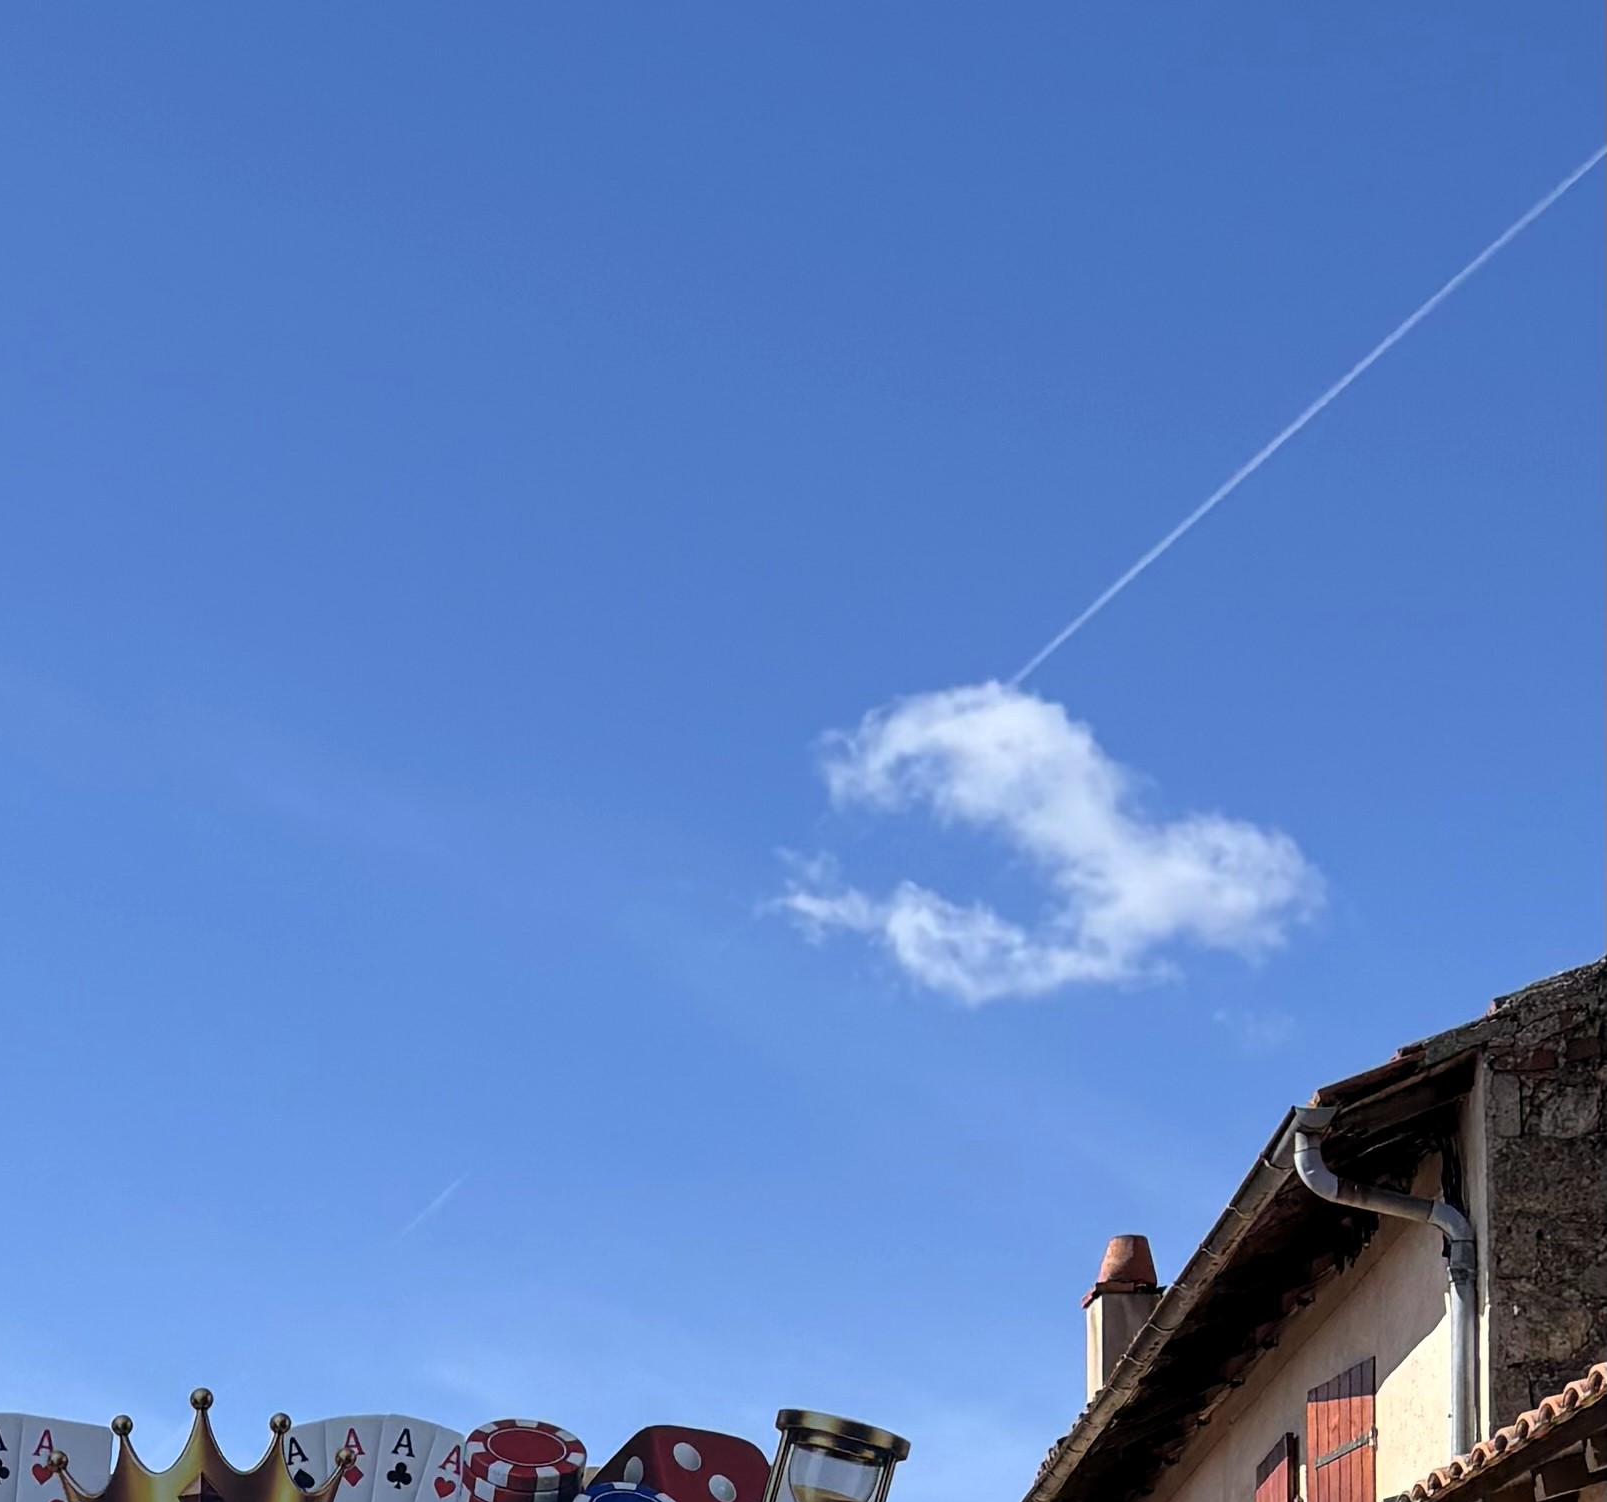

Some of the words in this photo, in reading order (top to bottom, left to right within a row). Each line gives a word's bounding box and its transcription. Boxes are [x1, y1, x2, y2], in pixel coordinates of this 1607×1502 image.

[32, 1429, 53, 1456] A
[287, 1437, 309, 1465] A
[344, 1428, 365, 1455] A
[391, 1428, 415, 1458] A
[438, 1445, 460, 1475] A
